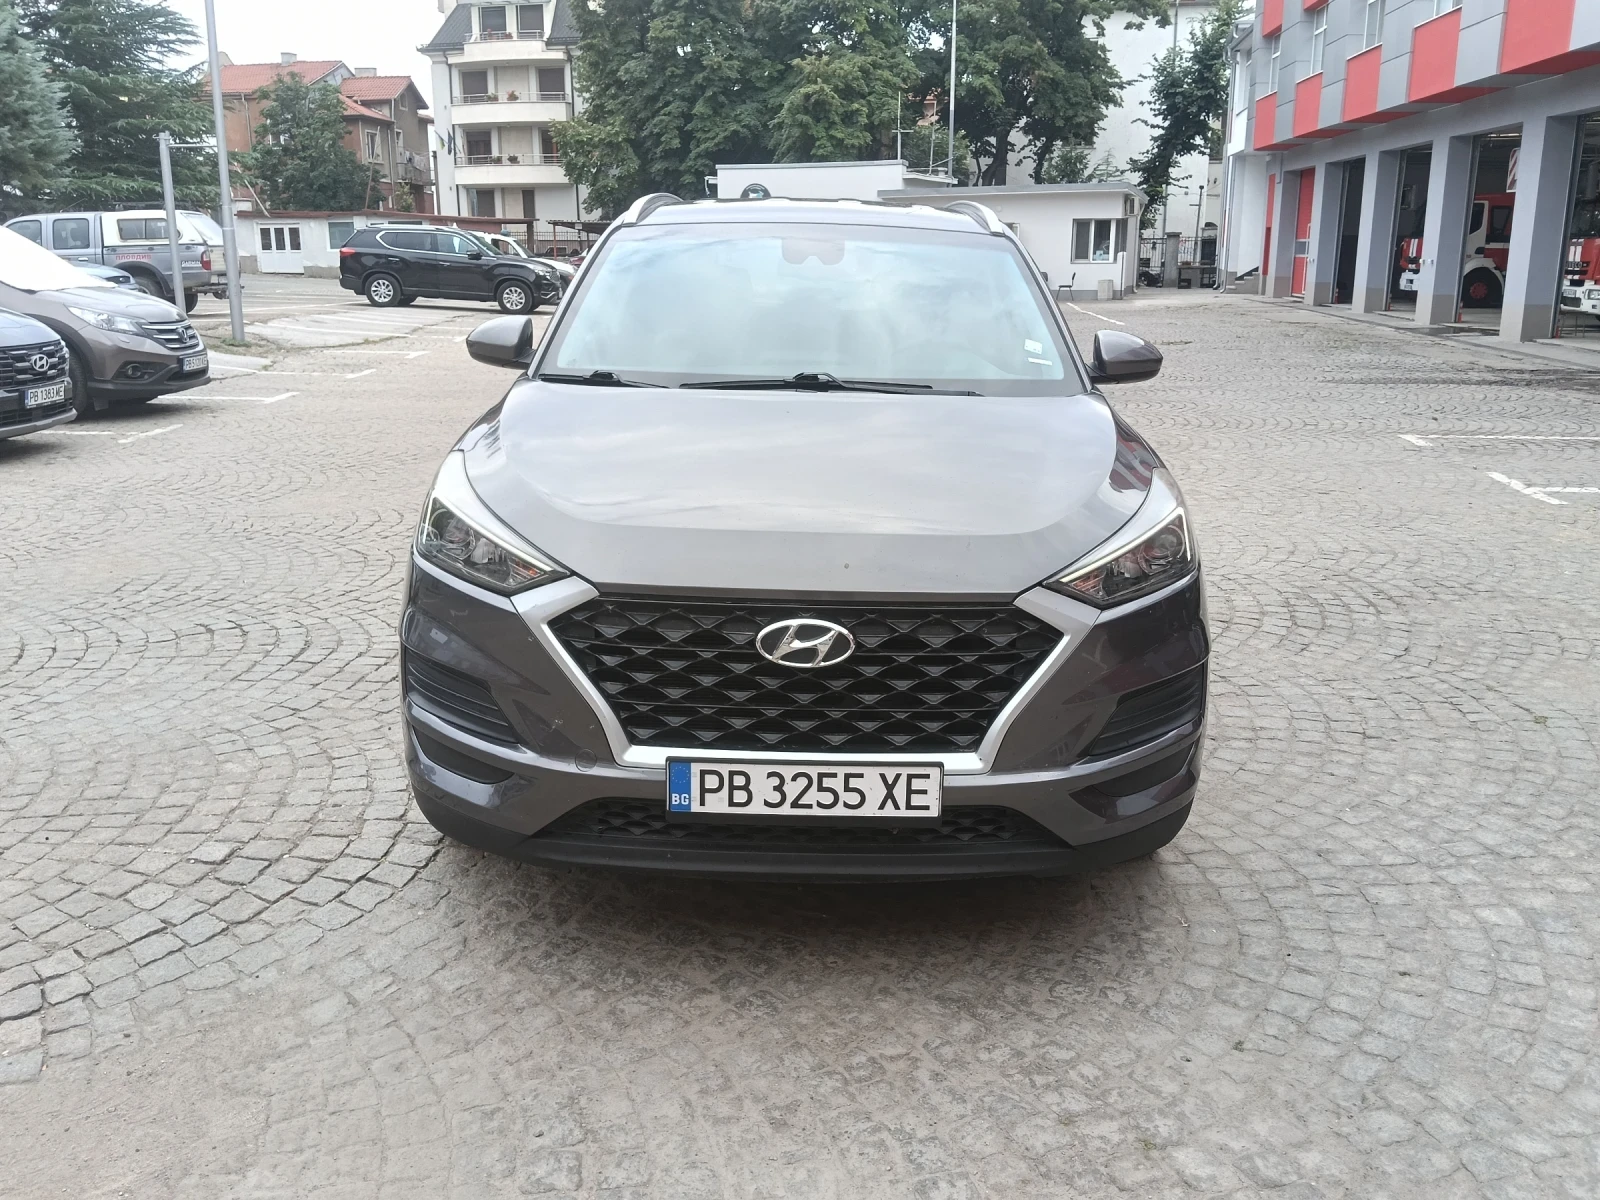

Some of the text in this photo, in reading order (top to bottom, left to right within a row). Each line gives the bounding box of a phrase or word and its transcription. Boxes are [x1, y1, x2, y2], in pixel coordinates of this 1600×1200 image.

[29, 390, 39, 403] PB
[699, 769, 931, 811] PB 3255 XE
[671, 793, 689, 805] BG
